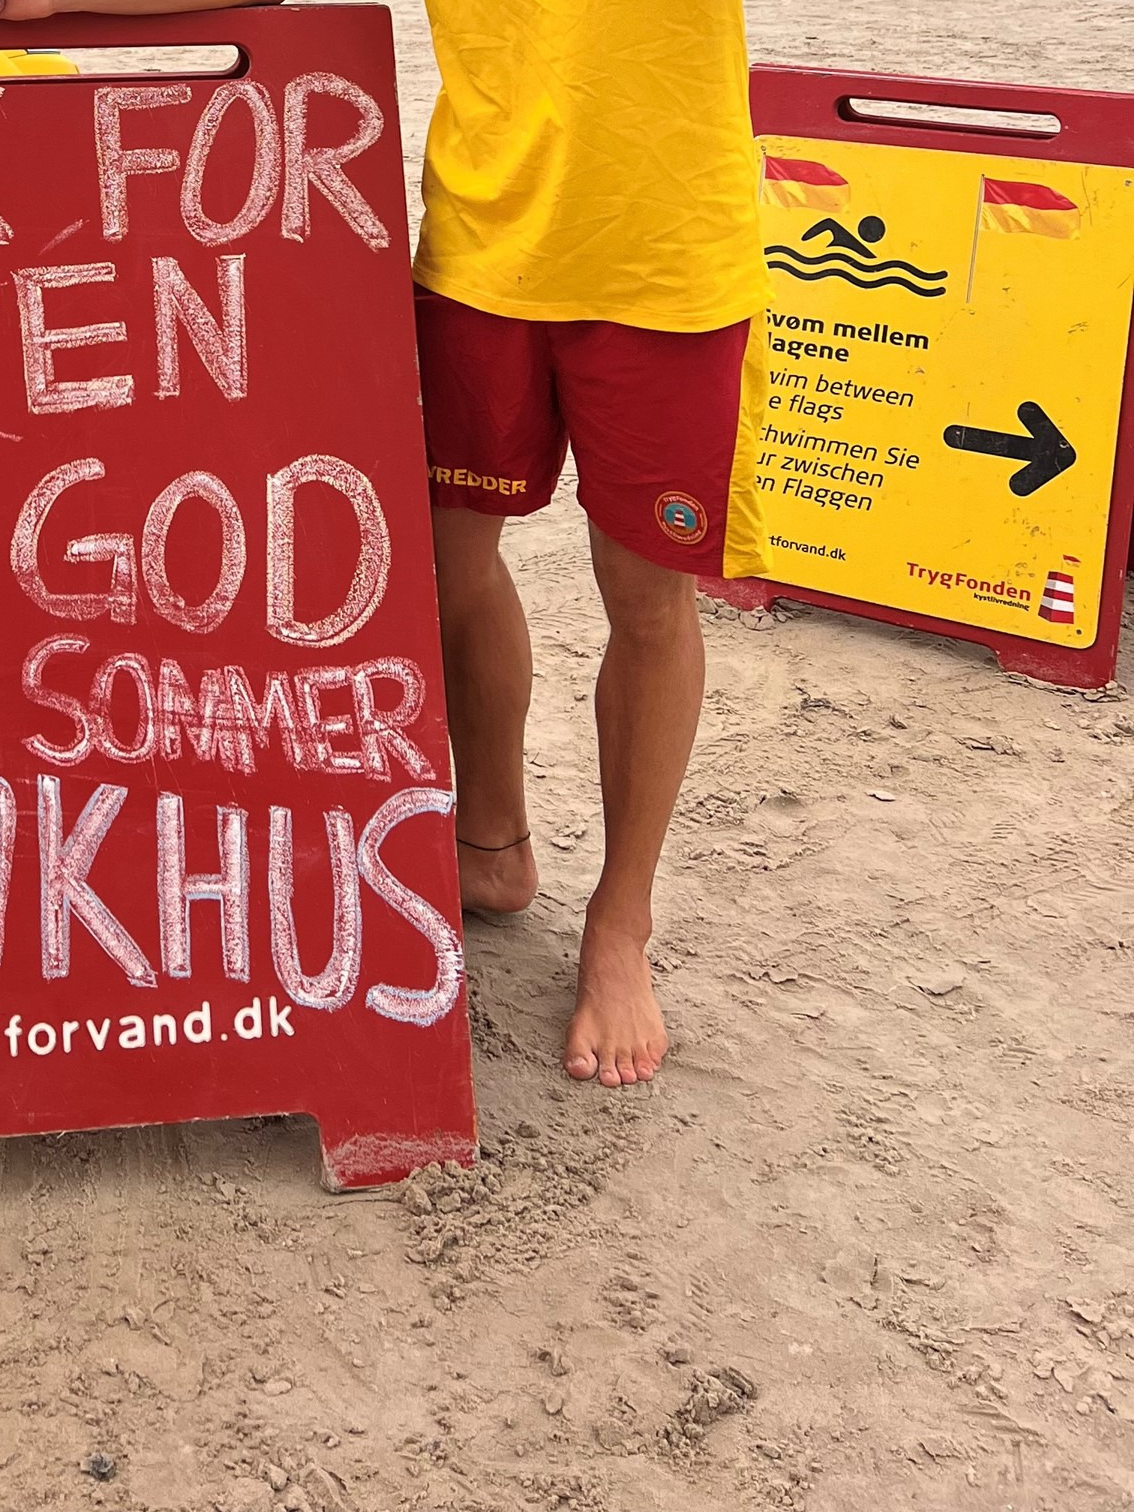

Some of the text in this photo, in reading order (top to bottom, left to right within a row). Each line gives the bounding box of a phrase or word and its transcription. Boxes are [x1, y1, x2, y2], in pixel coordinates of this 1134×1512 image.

[95, 71, 391, 253] FOR
[10, 253, 248, 415] EN
[767, 331, 850, 362] lagene
[833, 322, 929, 350] mellem
[815, 374, 914, 407] between
[788, 393, 845, 423] flags
[759, 423, 920, 470] hwimmen Sie
[780, 456, 884, 488] zwischen
[782, 477, 873, 512] Flaggen
[9, 453, 392, 648] GOD
[768, 535, 847, 561] tforvand.dk
[906, 562, 1032, 602] TrygFonden
[973, 592, 1031, 612] kystlivredning
[21, 632, 437, 783] SOMMER
